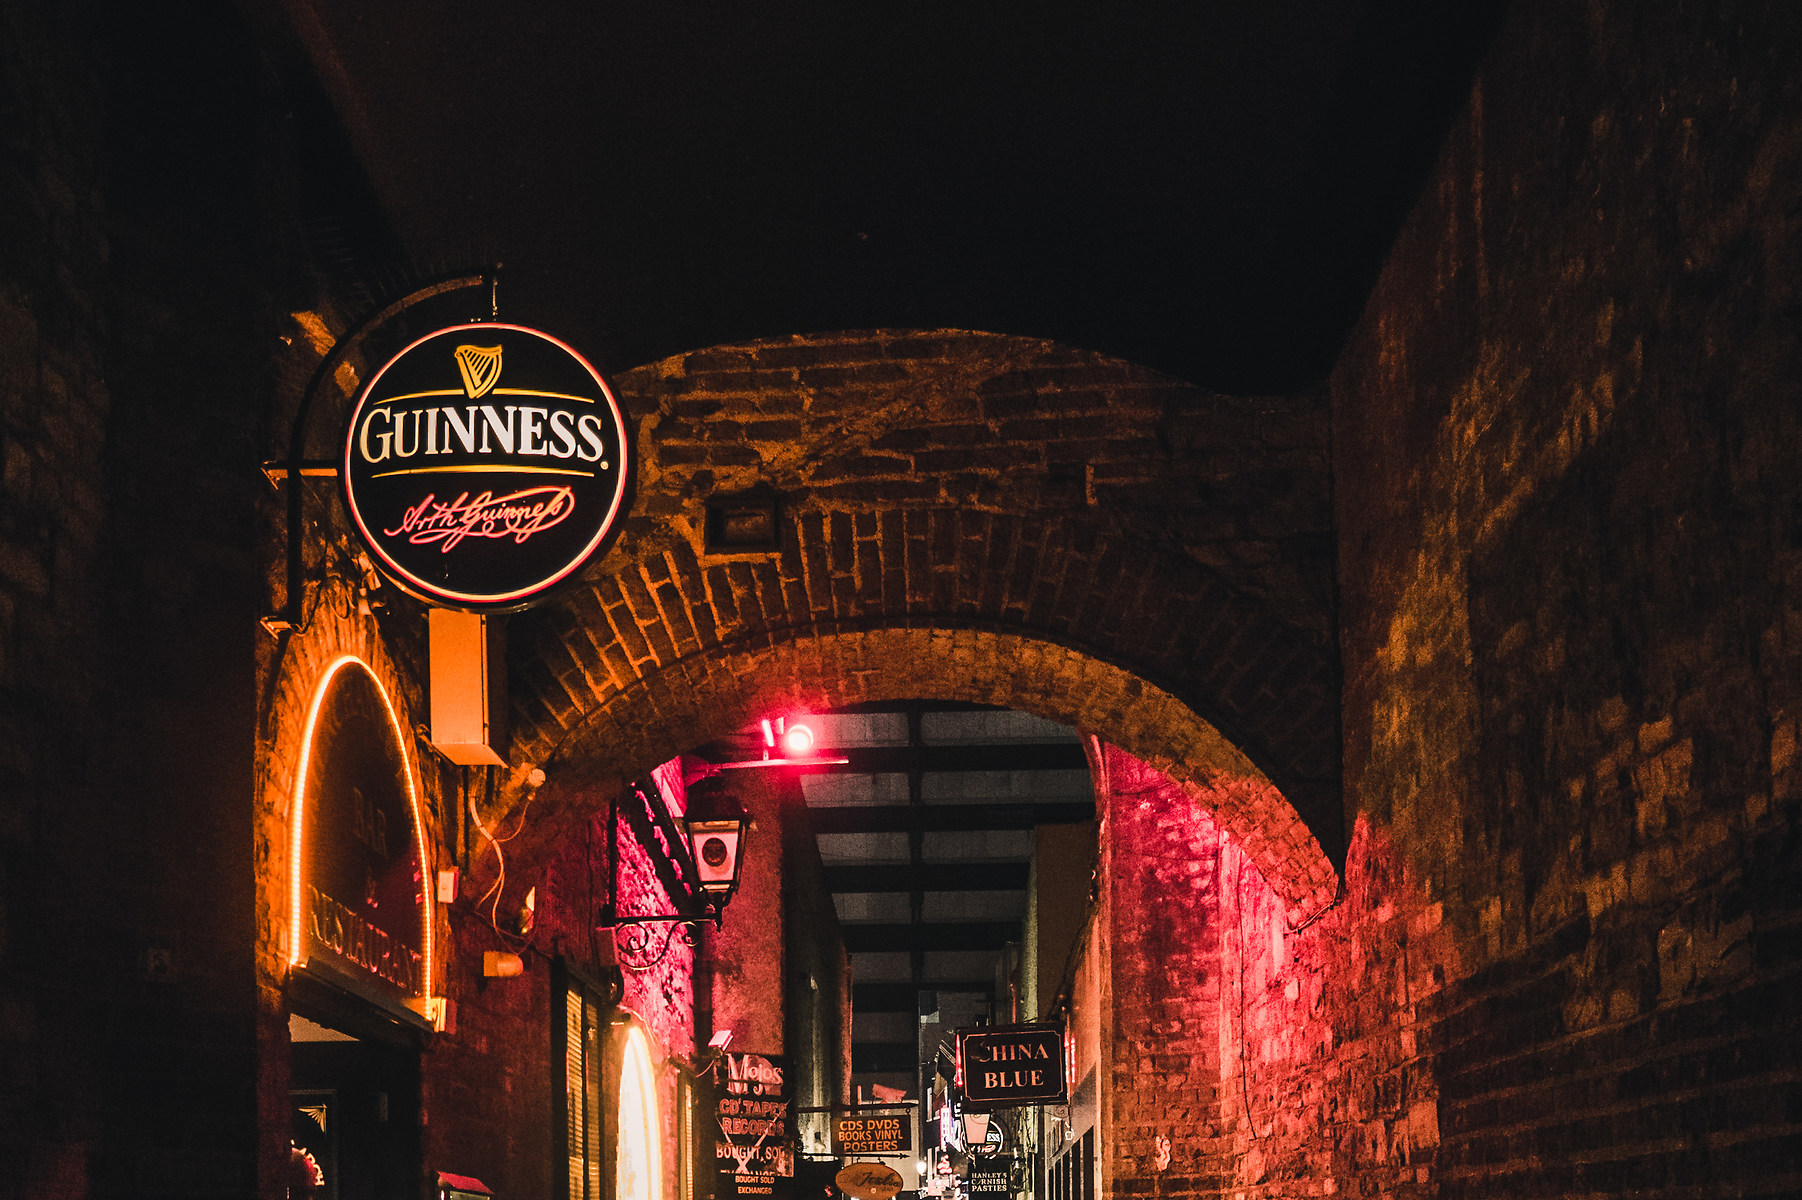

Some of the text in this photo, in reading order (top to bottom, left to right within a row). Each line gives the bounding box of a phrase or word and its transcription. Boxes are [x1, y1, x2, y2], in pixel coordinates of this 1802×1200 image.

[359, 405, 604, 463] GUINNESS
[984, 1069, 1044, 1089] BLUE
[742, 1100, 786, 1119] TAPES
[722, 1117, 784, 1136] RECORDS
[840, 1119, 900, 1131] CDS DVDS
[838, 1129, 903, 1142] BOOKS VINYL
[844, 1140, 898, 1152] POSTERS
[737, 1187, 773, 1195] EXCHANGED
